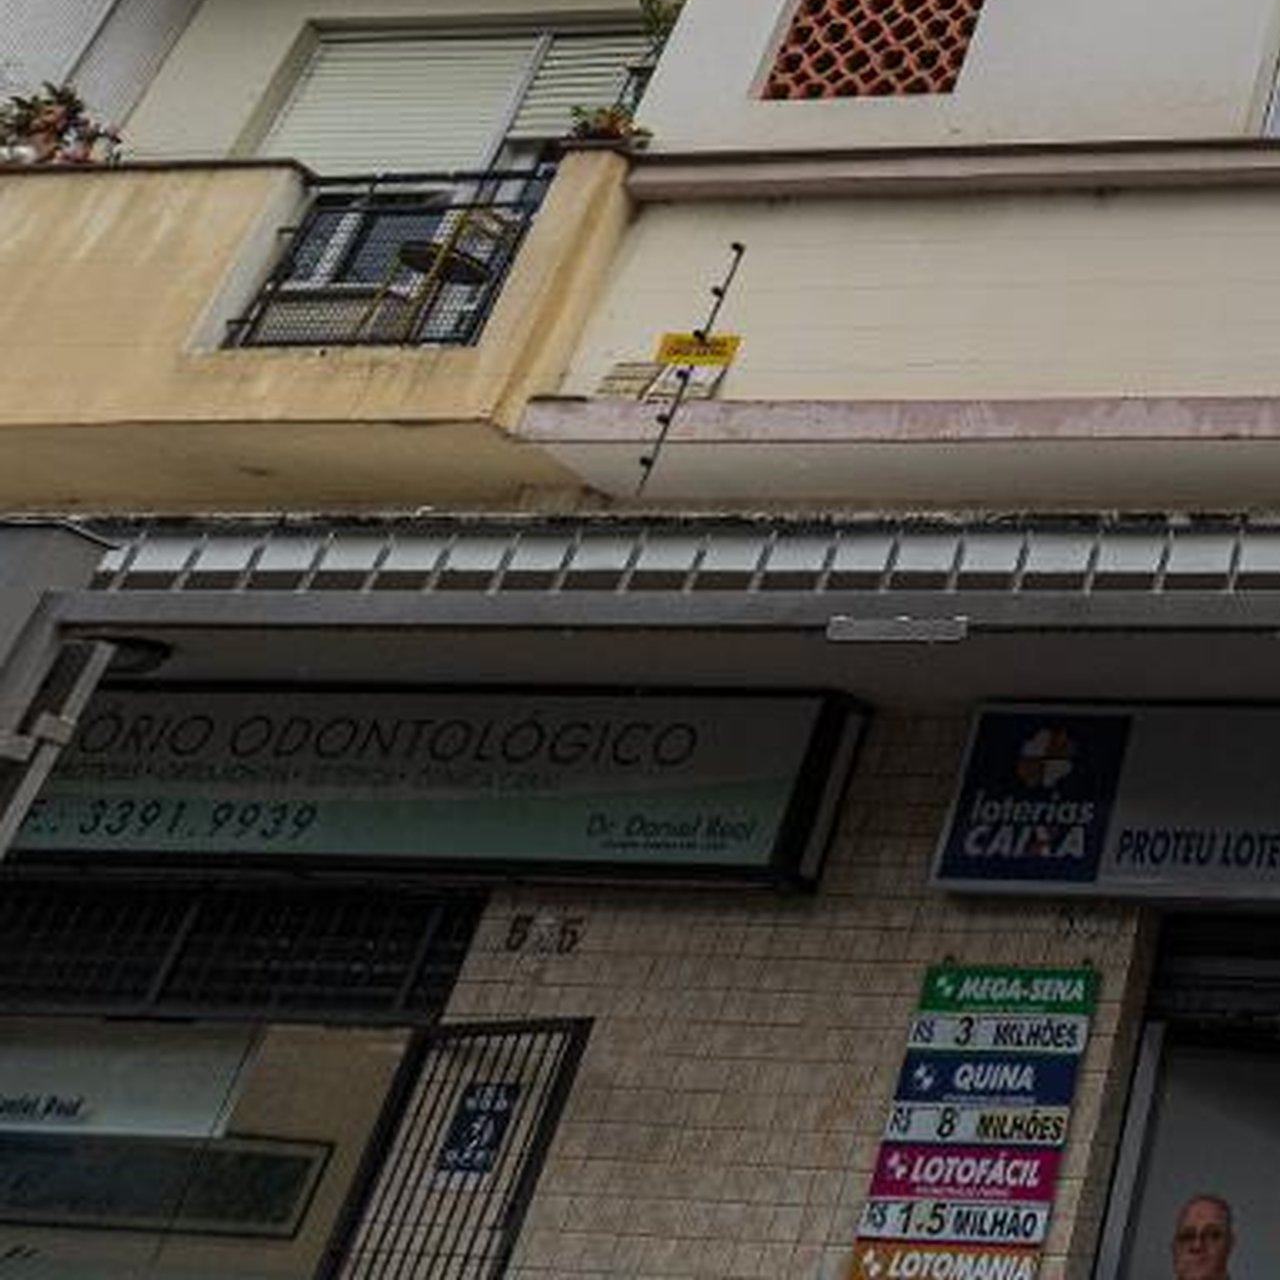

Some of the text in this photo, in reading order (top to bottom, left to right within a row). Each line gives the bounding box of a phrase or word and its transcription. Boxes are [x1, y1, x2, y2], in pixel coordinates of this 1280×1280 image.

[78, 701, 699, 767] ÓRIO ODONTOLÓGICO
[973, 791, 1095, 824] loterias
[963, 826, 1087, 859] CAIXA
[1115, 827, 1217, 866] PROTEU
[956, 975, 1085, 1003] MEGA-SENA
[954, 1015, 975, 1047] 3
[991, 1015, 1079, 1049] MILHÕES
[954, 1063, 1035, 1091] QUINA
[935, 1106, 960, 1139] 8
[975, 1108, 1065, 1142] MILHÕES
[910, 1151, 1040, 1188] LOTOFÁCIL
[952, 1205, 1038, 1238] MILHÃO
[886, 1250, 1036, 1280] LOTOMANIA
